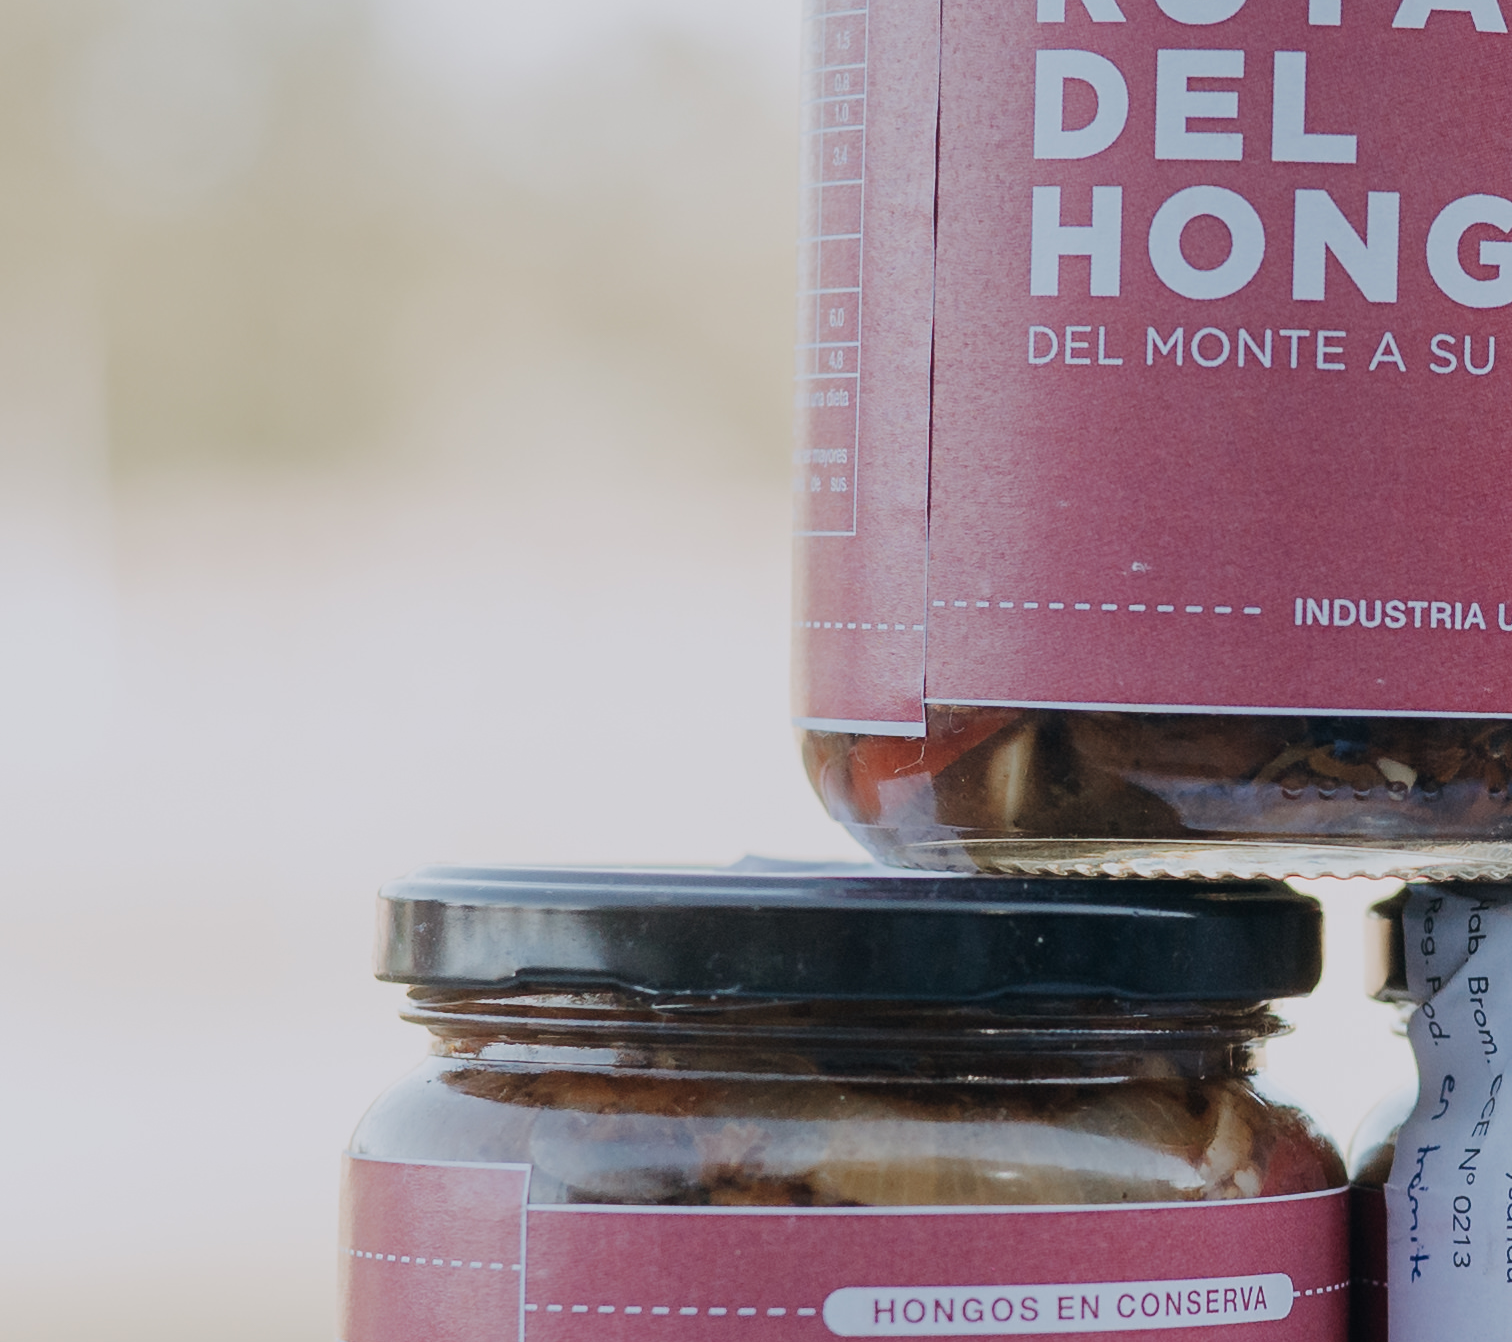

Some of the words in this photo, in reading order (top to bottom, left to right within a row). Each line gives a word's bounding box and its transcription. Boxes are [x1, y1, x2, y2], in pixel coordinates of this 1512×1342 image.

[1033, 49, 1356, 163] DEL
[829, 309, 844, 328] 6.0
[828, 350, 844, 369] 4.8
[1028, 326, 1123, 365] DEL
[1147, 327, 1346, 370] MONTE
[1369, 332, 1406, 371] A
[1430, 334, 1495, 374] SU
[826, 389, 849, 407] dieta
[1295, 598, 1486, 629] INDUSTRIA
[1421, 898, 1443, 965] Reg.
[1422, 976, 1451, 1046] Pod.
[1468, 976, 1498, 1064] Brom.
[1431, 1074, 1455, 1121] en
[1452, 1195, 1471, 1268] 0213
[874, 1297, 1038, 1324] HONGOS
[1058, 1295, 1099, 1320] EN
[1117, 1286, 1267, 1318] CONSERVA
